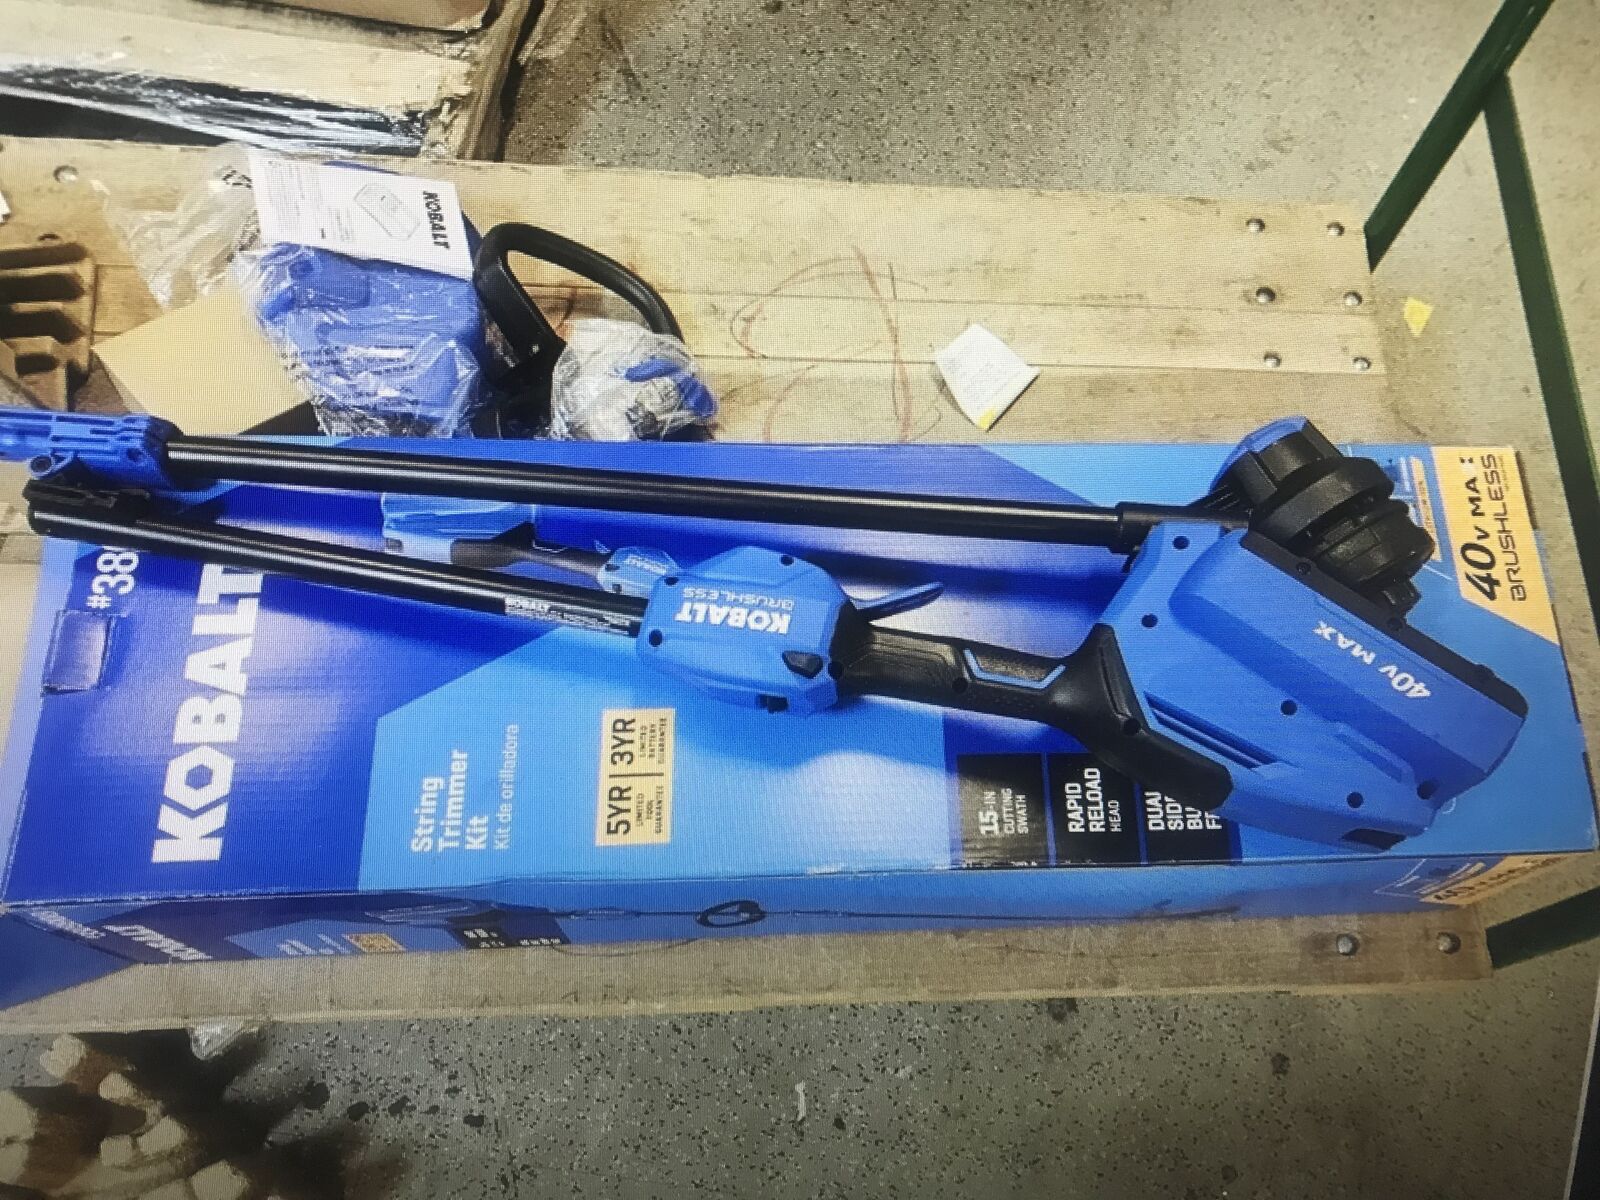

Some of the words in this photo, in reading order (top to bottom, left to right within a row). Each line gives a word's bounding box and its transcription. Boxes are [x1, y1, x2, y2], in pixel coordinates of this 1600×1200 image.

[1481, 453, 1527, 602] BRUSHLESS
[86, 545, 140, 609] #38
[683, 587, 795, 611] BRUSHLESS
[674, 601, 791, 635] KOBALT
[1312, 620, 1376, 665] MAX
[151, 563, 263, 863] KOBALT
[499, 724, 519, 800] orilladora
[611, 718, 636, 766] 3YR
[411, 776, 445, 852] String
[438, 748, 469, 852] Trimmer
[496, 803, 512, 825] de
[606, 785, 632, 835] 5YR
[1001, 788, 1016, 834] CUTTING
[1016, 794, 1029, 834] SWATH
[1065, 783, 1086, 832] RAPID
[1084, 767, 1106, 832] RELOAD
[1108, 800, 1123, 832] HEAD
[465, 815, 489, 850] Kit
[494, 826, 511, 850] Kit
